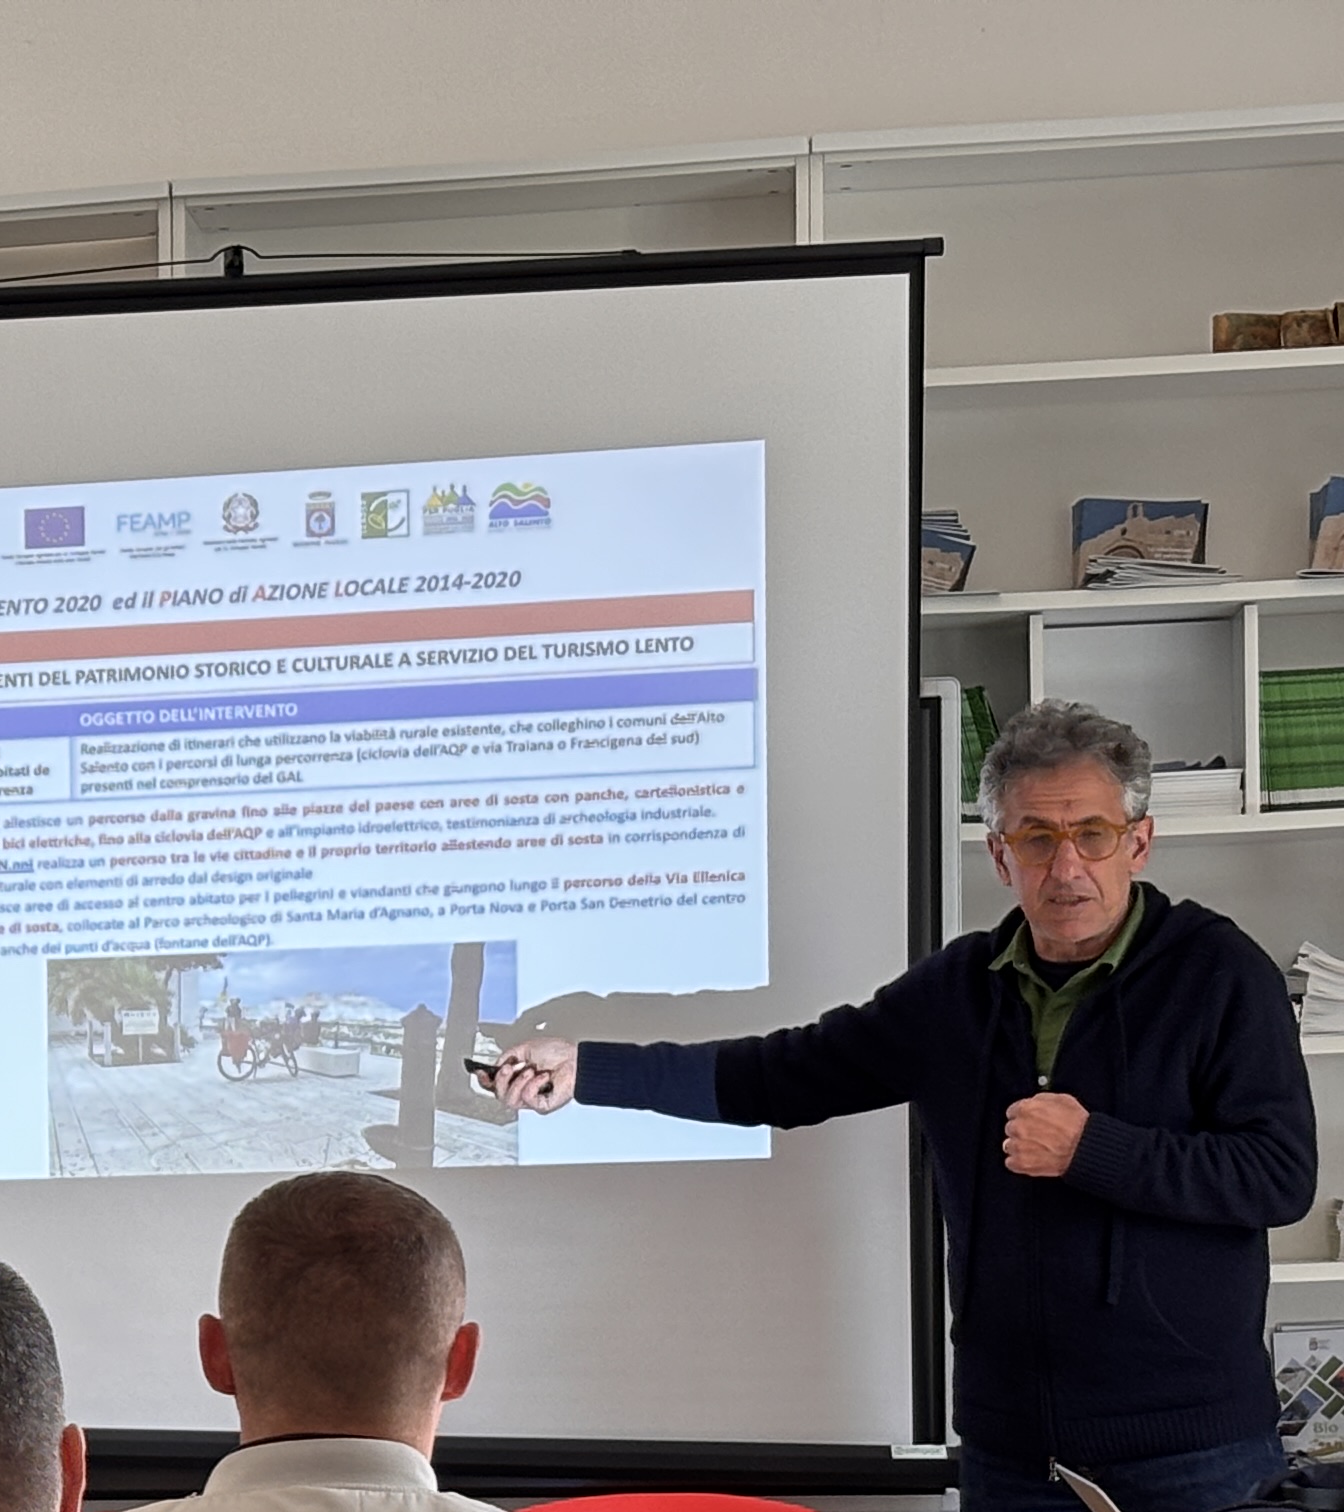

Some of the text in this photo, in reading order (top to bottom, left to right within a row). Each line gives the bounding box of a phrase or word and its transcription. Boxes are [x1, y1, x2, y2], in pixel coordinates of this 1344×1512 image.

[116, 511, 191, 533] FEAMP
[54, 594, 102, 613] 2020
[112, 591, 137, 610] ed
[142, 590, 154, 608] il
[159, 587, 223, 608] PIANO
[228, 585, 248, 604] di
[252, 581, 328, 602] AZIONE
[334, 576, 409, 597] LOCALE
[414, 570, 521, 593] 2014-2020
[38, 670, 69, 686] DEL
[75, 664, 189, 685] PATRIMONIO
[194, 659, 271, 679] STORICO
[291, 652, 393, 673] CULTURALE
[416, 647, 498, 666] SERVIZIO
[503, 644, 537, 661] DEL
[543, 639, 629, 659] TURISMO
[634, 636, 696, 654] LENTO
[80, 709, 154, 727] OGGETTO
[80, 741, 165, 755] Realizzazione
[168, 738, 180, 751] di
[183, 736, 234, 750] itinerari
[238, 734, 260, 748] che
[264, 732, 326, 746] utilizzano
[329, 730, 340, 743] la
[399, 725, 438, 739] rurale
[508, 720, 533, 734] che
[536, 717, 605, 733] colleghino
[616, 713, 666, 728] comuni
[131, 760, 155, 772] con
[166, 755, 217, 773] percorsi
[220, 754, 232, 768] di
[236, 753, 271, 769] lunga
[482, 742, 502, 754] via
[507, 740, 553, 752] Traiana
[670, 730, 700, 745] sud)
[33, 764, 50, 776] de
[80, 778, 133, 795] presenti
[136, 776, 156, 790] nel
[252, 771, 273, 785] del
[276, 770, 303, 783] GAL
[1313, 1422, 1339, 1434] Bio
